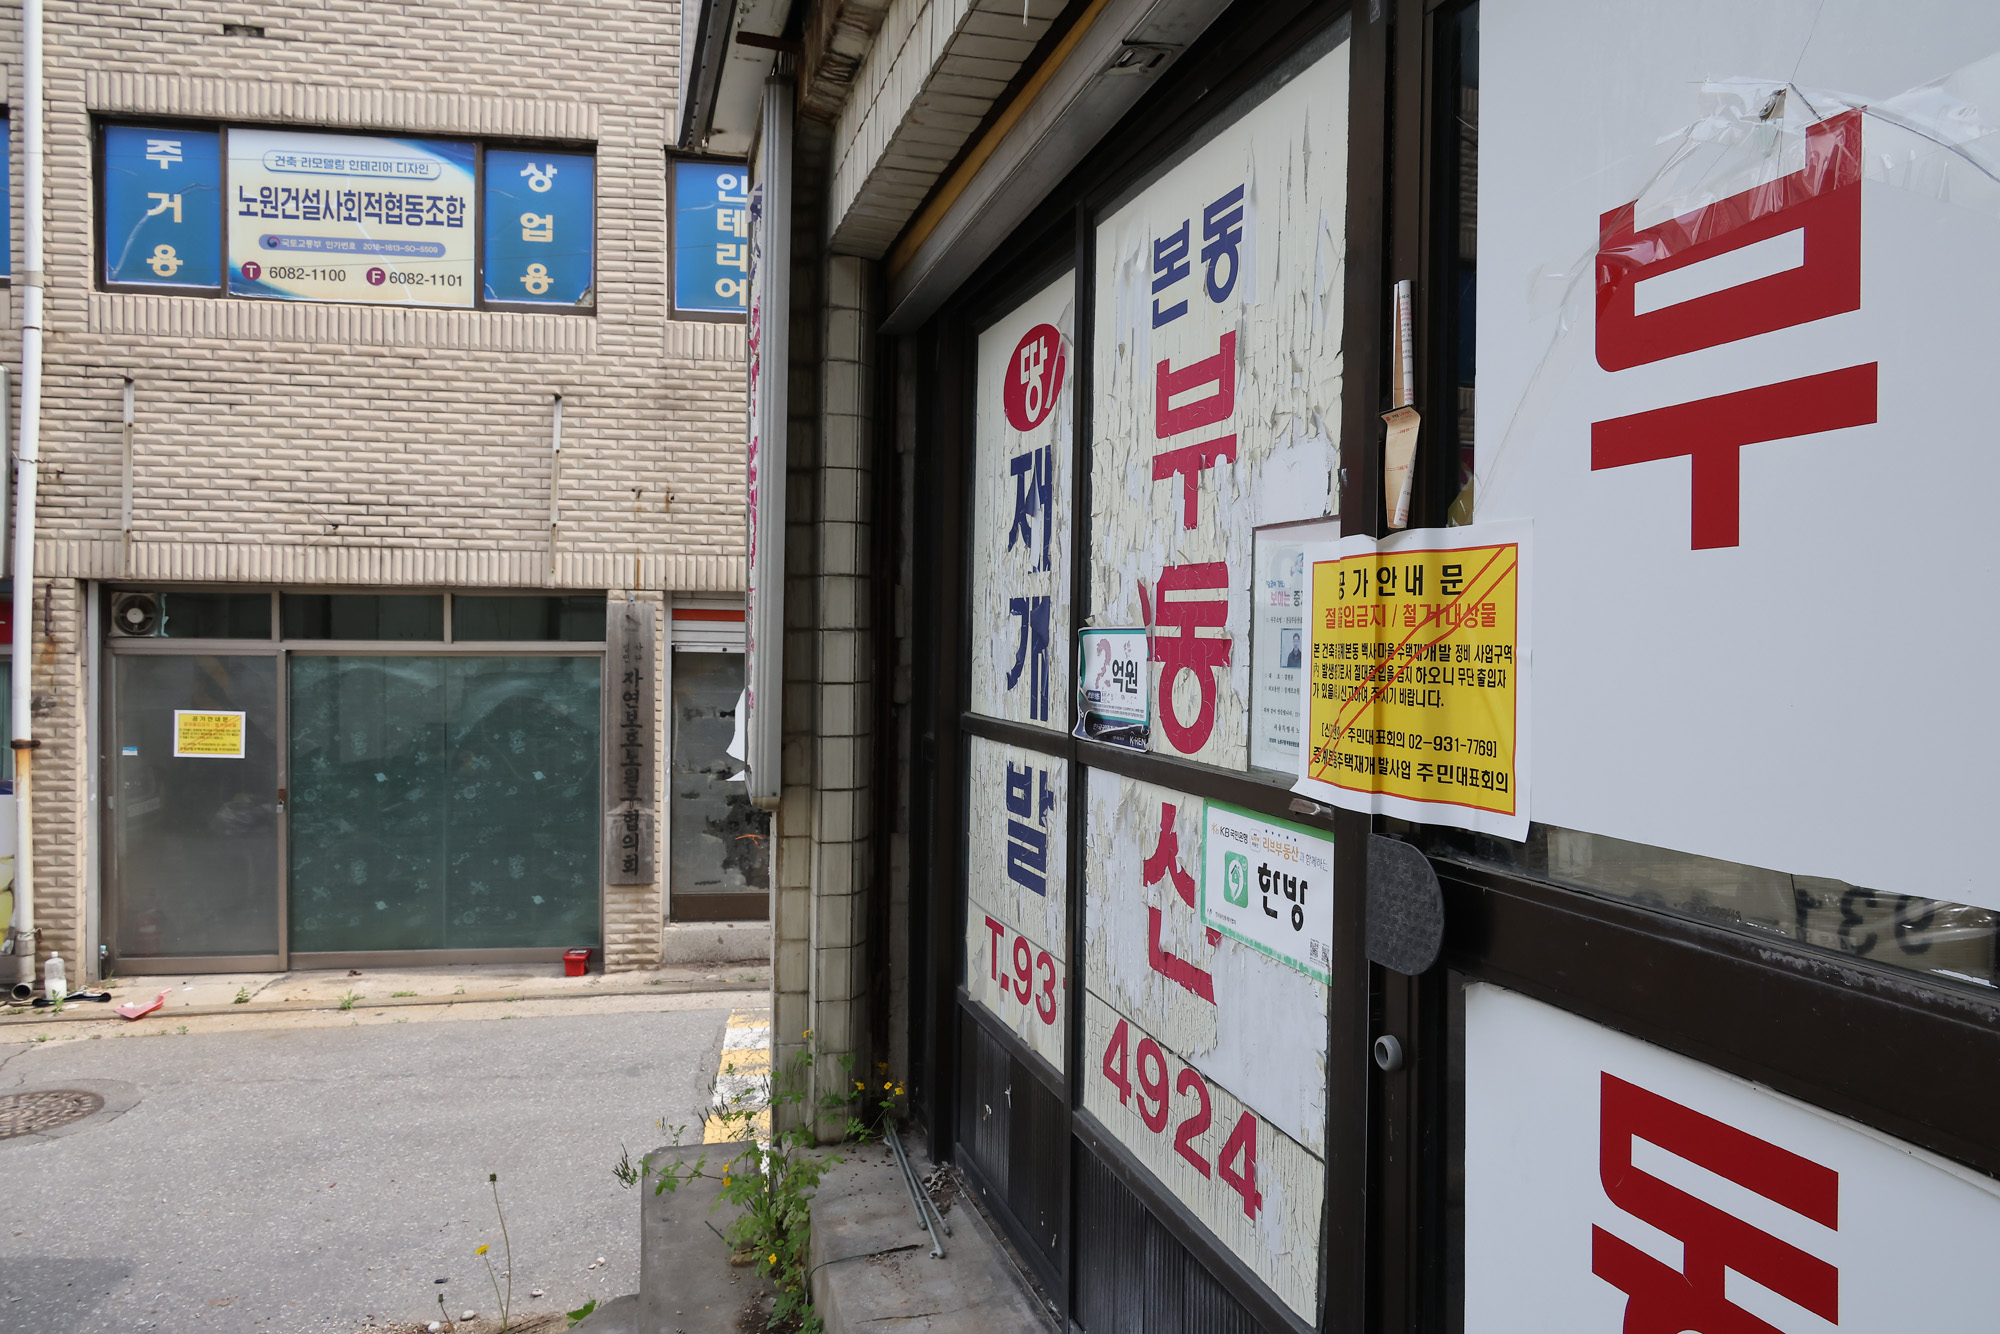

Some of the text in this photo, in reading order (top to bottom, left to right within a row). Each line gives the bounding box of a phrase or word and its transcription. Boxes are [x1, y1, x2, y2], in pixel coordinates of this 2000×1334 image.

[274, 155, 429, 175] 건축 리모델링 인테리어 디자인
[146, 139, 183, 277] 주거용
[239, 185, 466, 228] 노원건설사회적협동조합
[520, 163, 557, 295] 상업용
[1152, 184, 1245, 330] 본동
[269, 266, 347, 283] 6082-1100
[389, 272, 463, 288] 6082-1101
[1402, 602, 1497, 629] 철거대상물
[1455, 644, 1471, 664] 정비
[1474, 644, 1513, 665] 사업구역
[1007, 444, 1054, 897] 재개발
[1416, 666, 1455, 687] 하오니
[1458, 668, 1475, 687] 무단
[1477, 669, 1507, 688] 출입자
[1399, 688, 1445, 709] 바랍니다.
[1348, 728, 1405, 749] 주민대표회의
[1416, 763, 1508, 794] 주민대표회의
[1258, 862, 1308, 932] 한방
[1103, 1018, 1262, 1222] 4924
